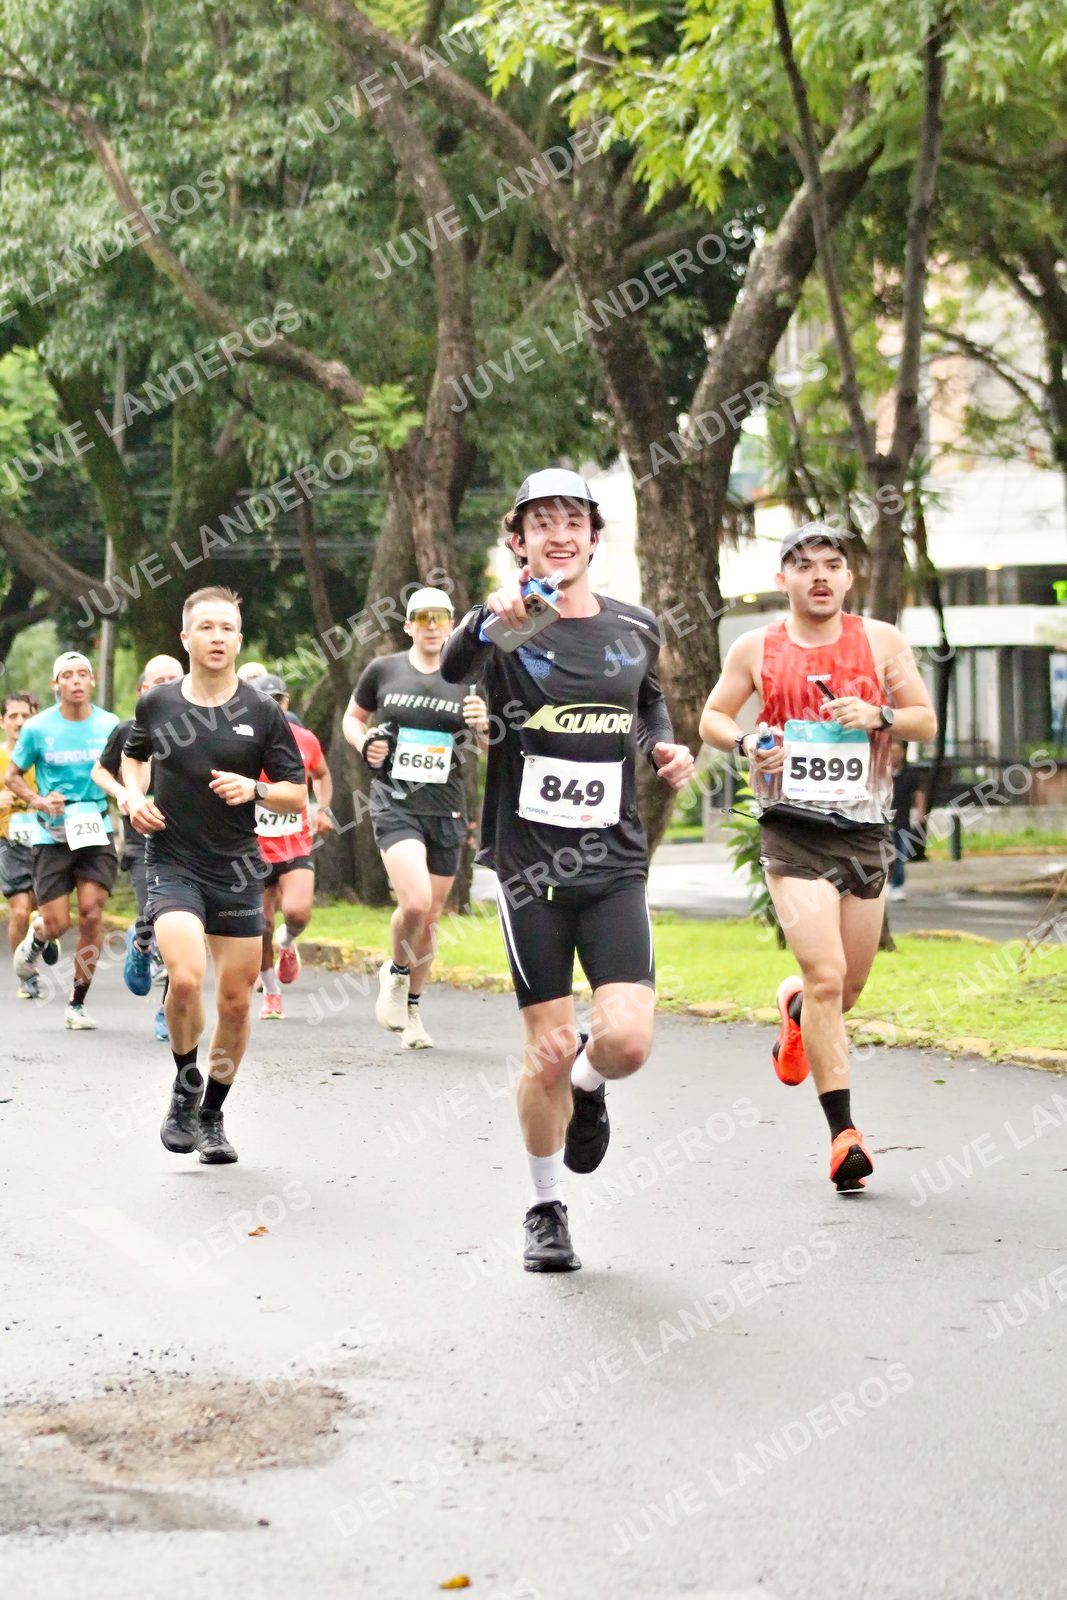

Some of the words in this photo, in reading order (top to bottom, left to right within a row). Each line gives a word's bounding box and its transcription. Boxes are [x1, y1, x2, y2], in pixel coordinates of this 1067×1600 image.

[399, 752, 446, 771] 6684
[790, 756, 863, 781] 5899
[539, 775, 605, 807] 849
[74, 822, 100, 836] 230
